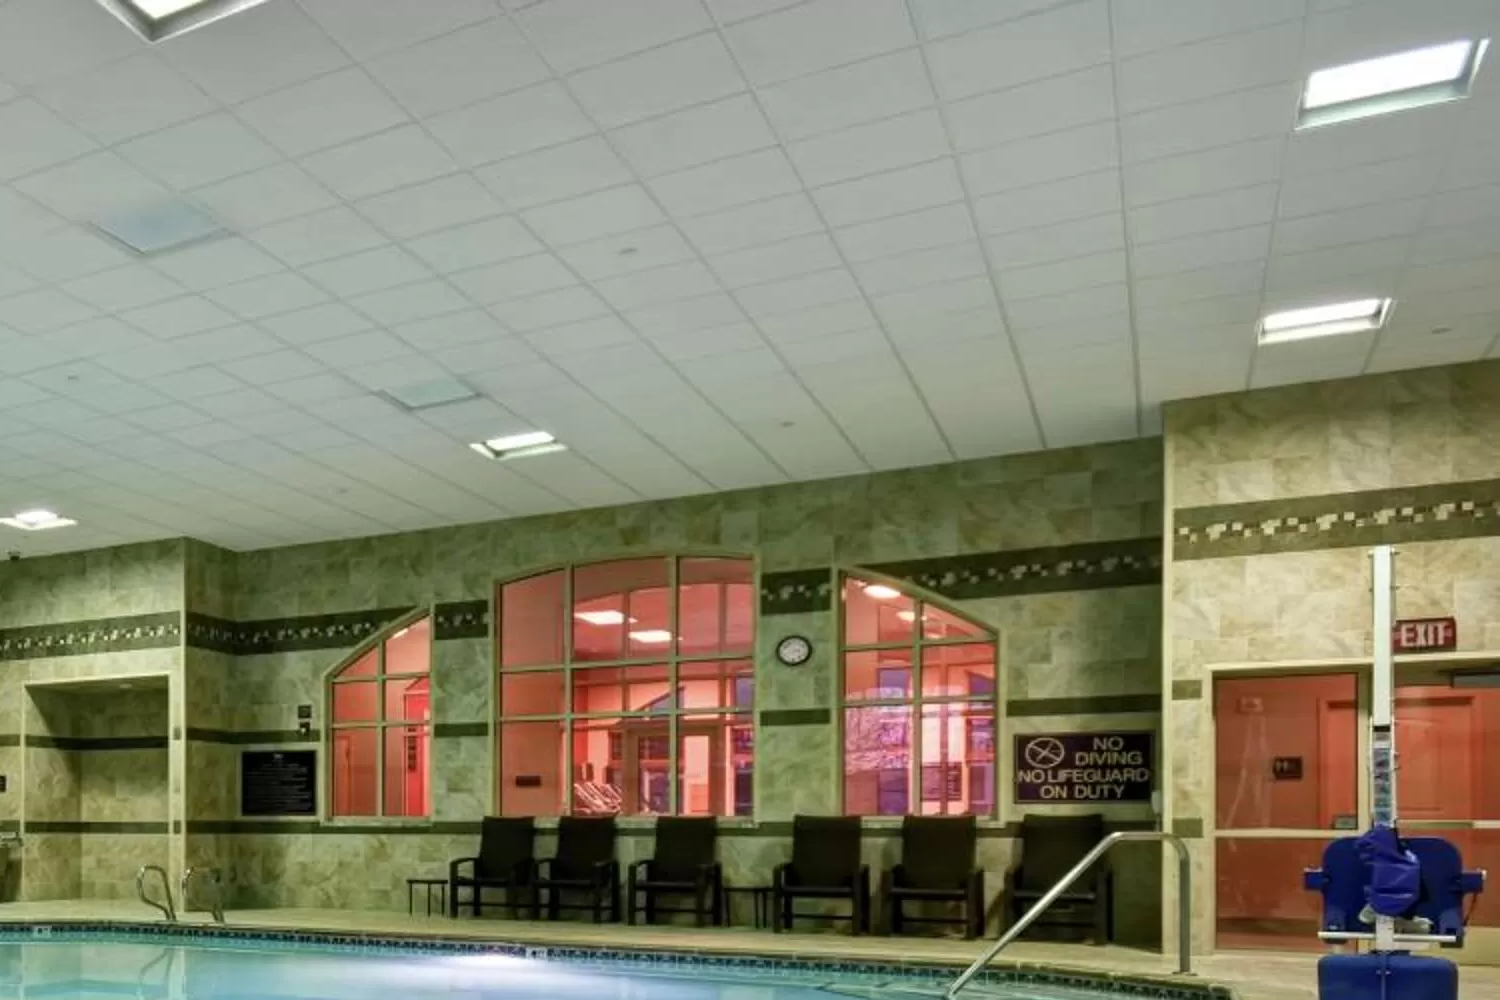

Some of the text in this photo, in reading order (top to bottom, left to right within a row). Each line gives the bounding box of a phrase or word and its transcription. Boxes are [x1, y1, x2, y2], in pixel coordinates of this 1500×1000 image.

[1400, 623, 1449, 647] EXIT
[1092, 736, 1124, 751] NO
[1074, 751, 1143, 767] DIVING
[1018, 767, 1149, 783] NO LIFEGUARD
[1039, 785, 1126, 799] ON DUTY
